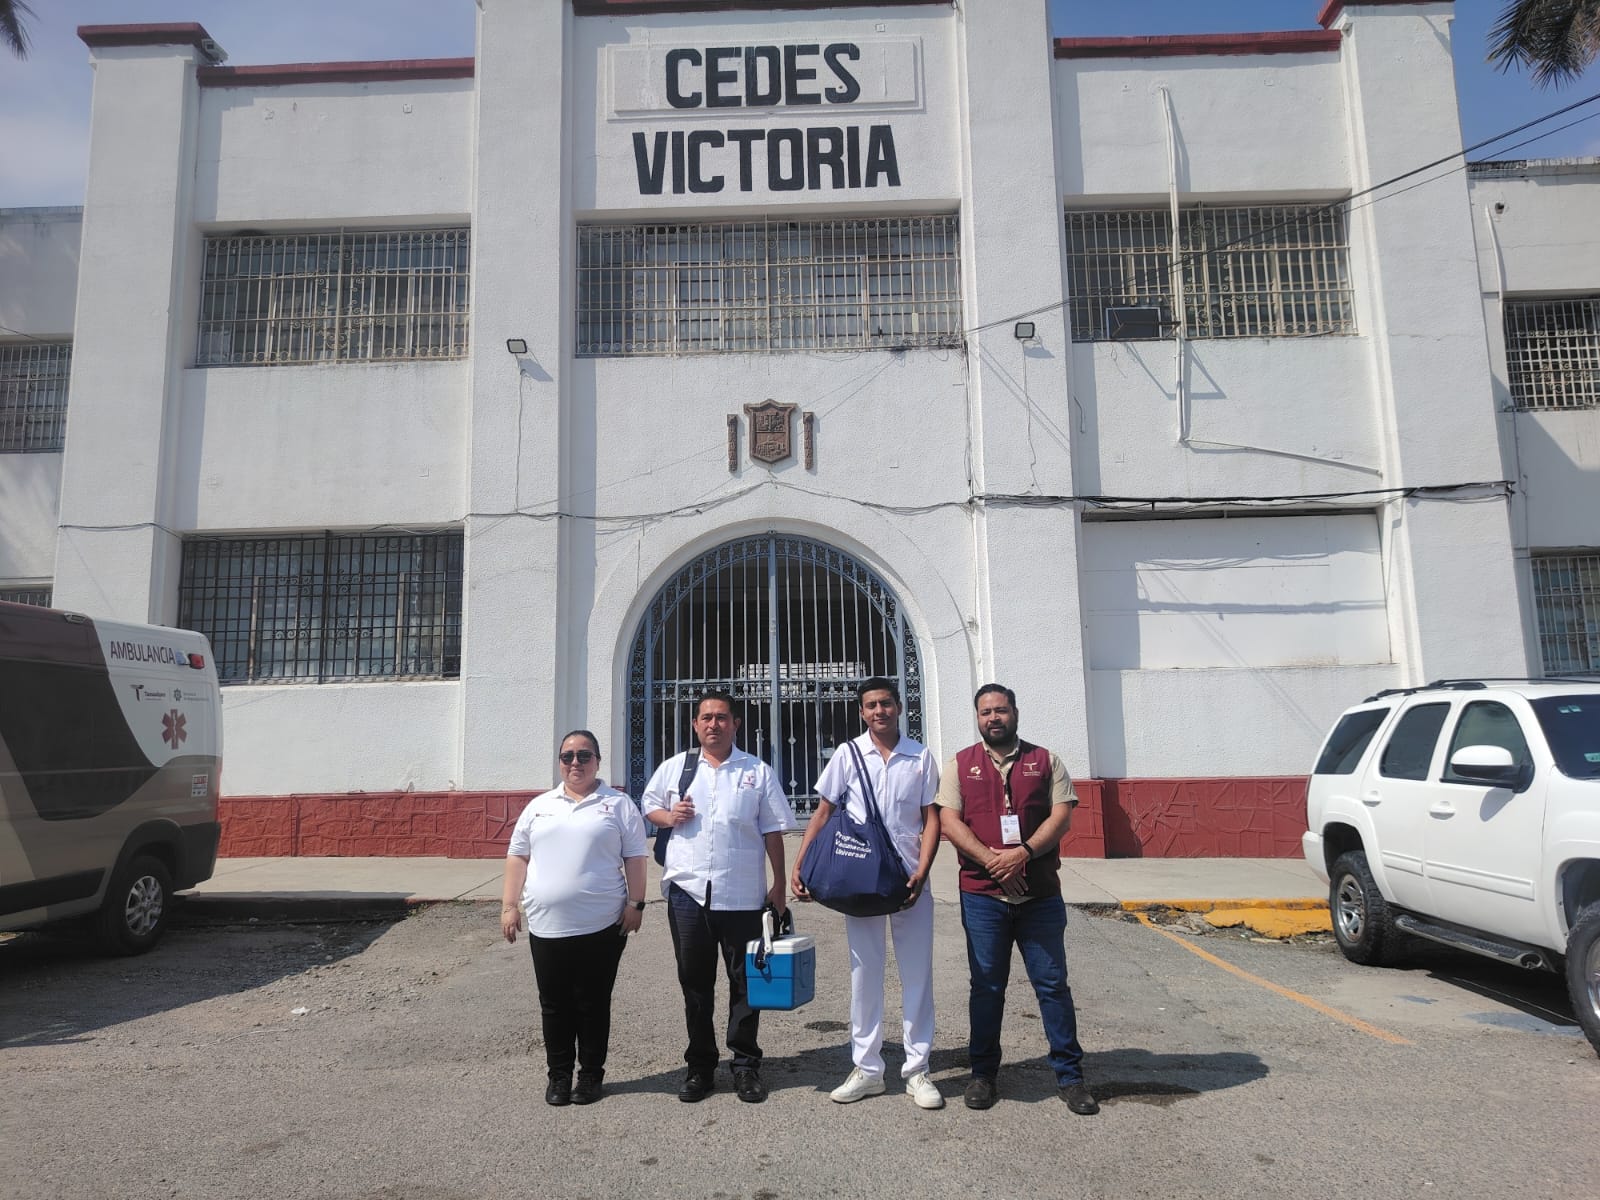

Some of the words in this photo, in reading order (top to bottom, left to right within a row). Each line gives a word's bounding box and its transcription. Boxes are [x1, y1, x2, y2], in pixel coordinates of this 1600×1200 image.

[665, 42, 861, 109] CEDES
[632, 124, 902, 195] VICTORIA
[110, 641, 176, 665] AMBULANCIA
[835, 847, 867, 860] Universal
